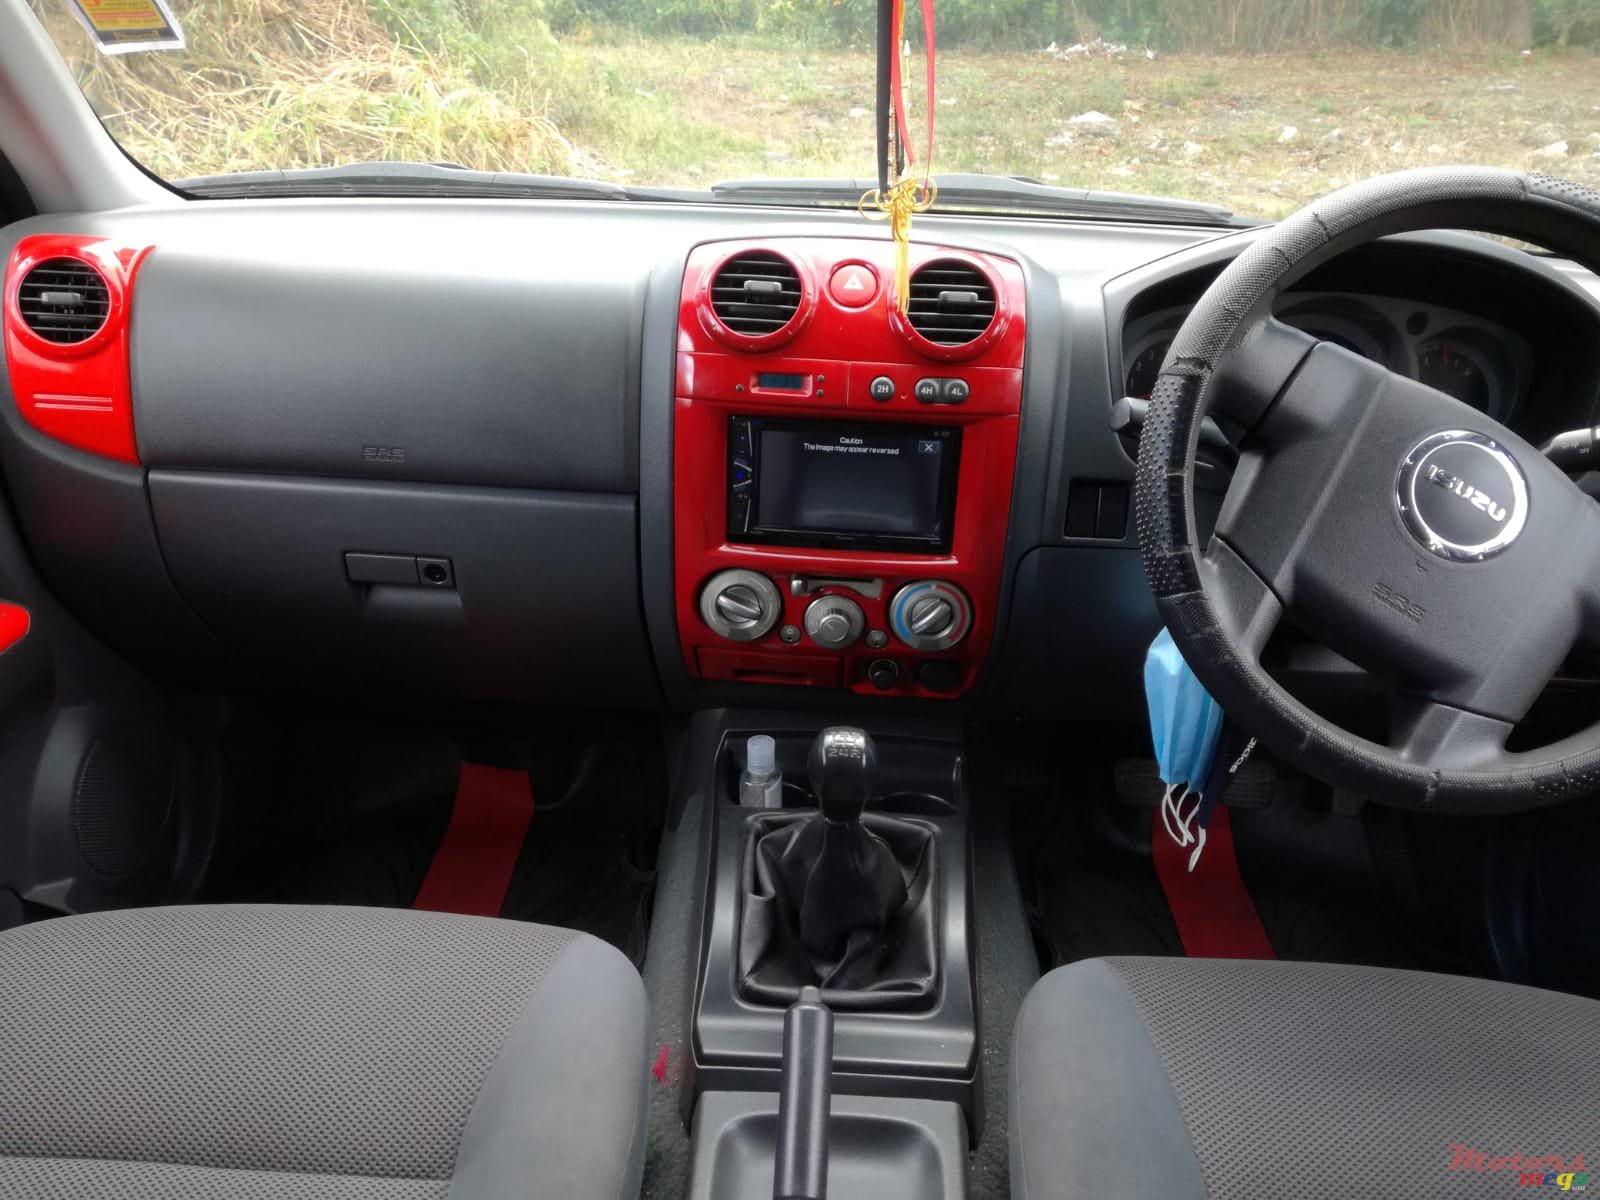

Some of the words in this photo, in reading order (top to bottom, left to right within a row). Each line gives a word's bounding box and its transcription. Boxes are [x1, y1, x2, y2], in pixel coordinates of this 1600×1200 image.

[877, 385, 889, 393] 2H
[921, 387, 933, 395] 4H
[951, 388, 963, 396] 4L
[839, 437, 863, 445] Caution
[1424, 464, 1507, 522] ISUZU
